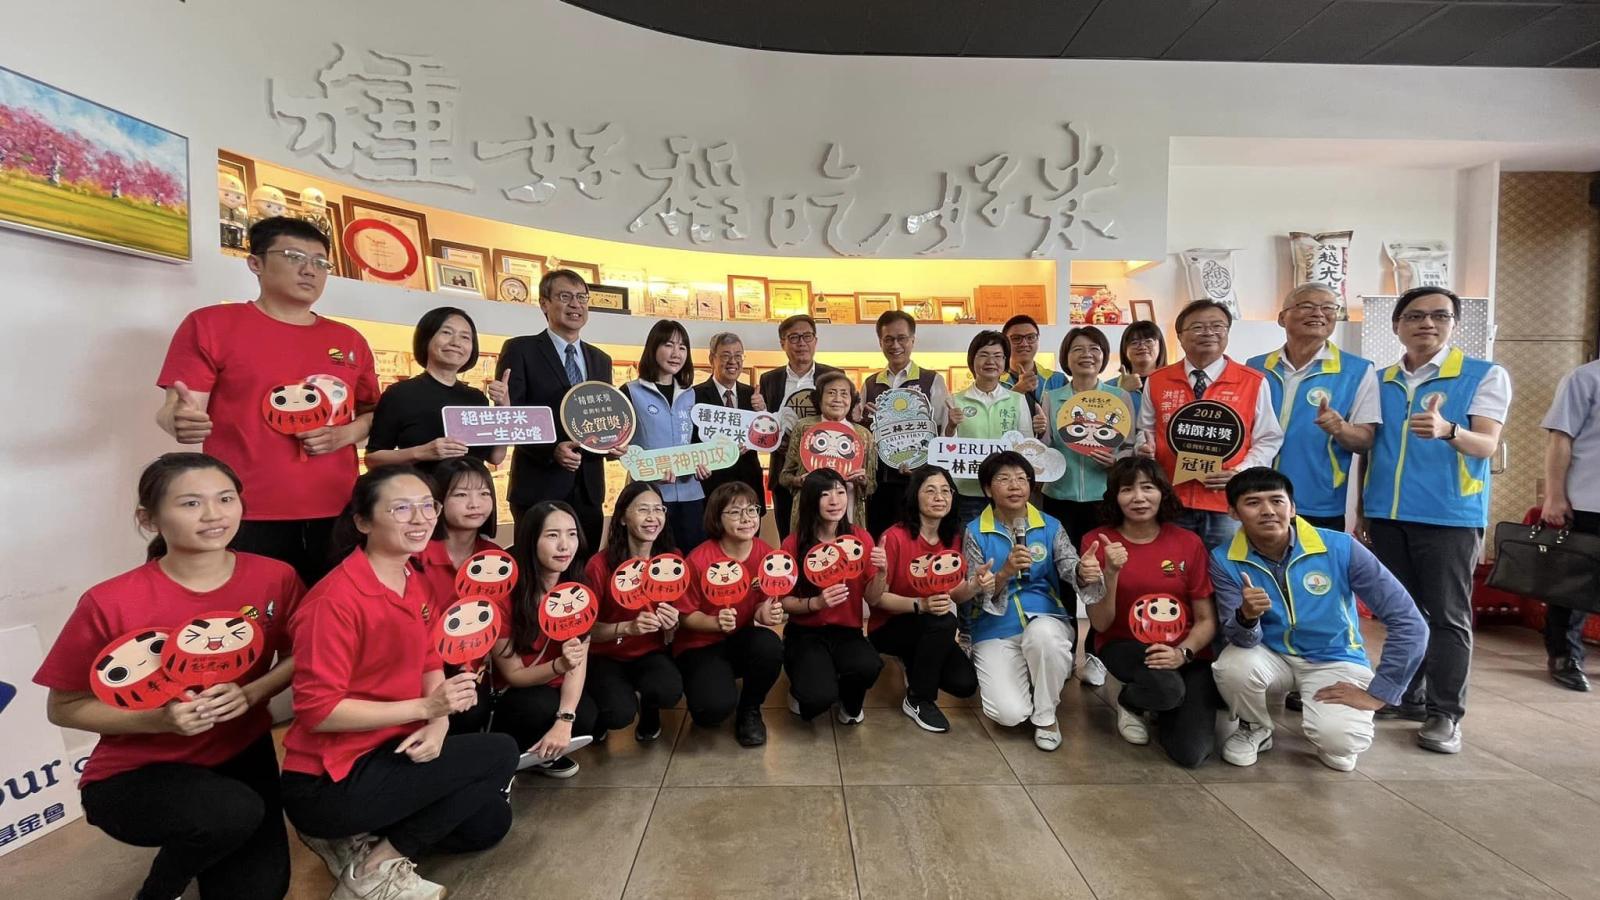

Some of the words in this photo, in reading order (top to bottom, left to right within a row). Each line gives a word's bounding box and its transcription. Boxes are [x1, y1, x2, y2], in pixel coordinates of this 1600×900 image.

[460, 410, 529, 426] 絕世好米
[698, 408, 742, 427] 種好稻
[1193, 408, 1223, 419] 2018
[581, 415, 622, 433] 金質獎
[880, 421, 928, 437] 二林之光
[938, 442, 943, 454] I
[958, 443, 1008, 456] ERLIN
[1181, 456, 1216, 474] 冠軍
